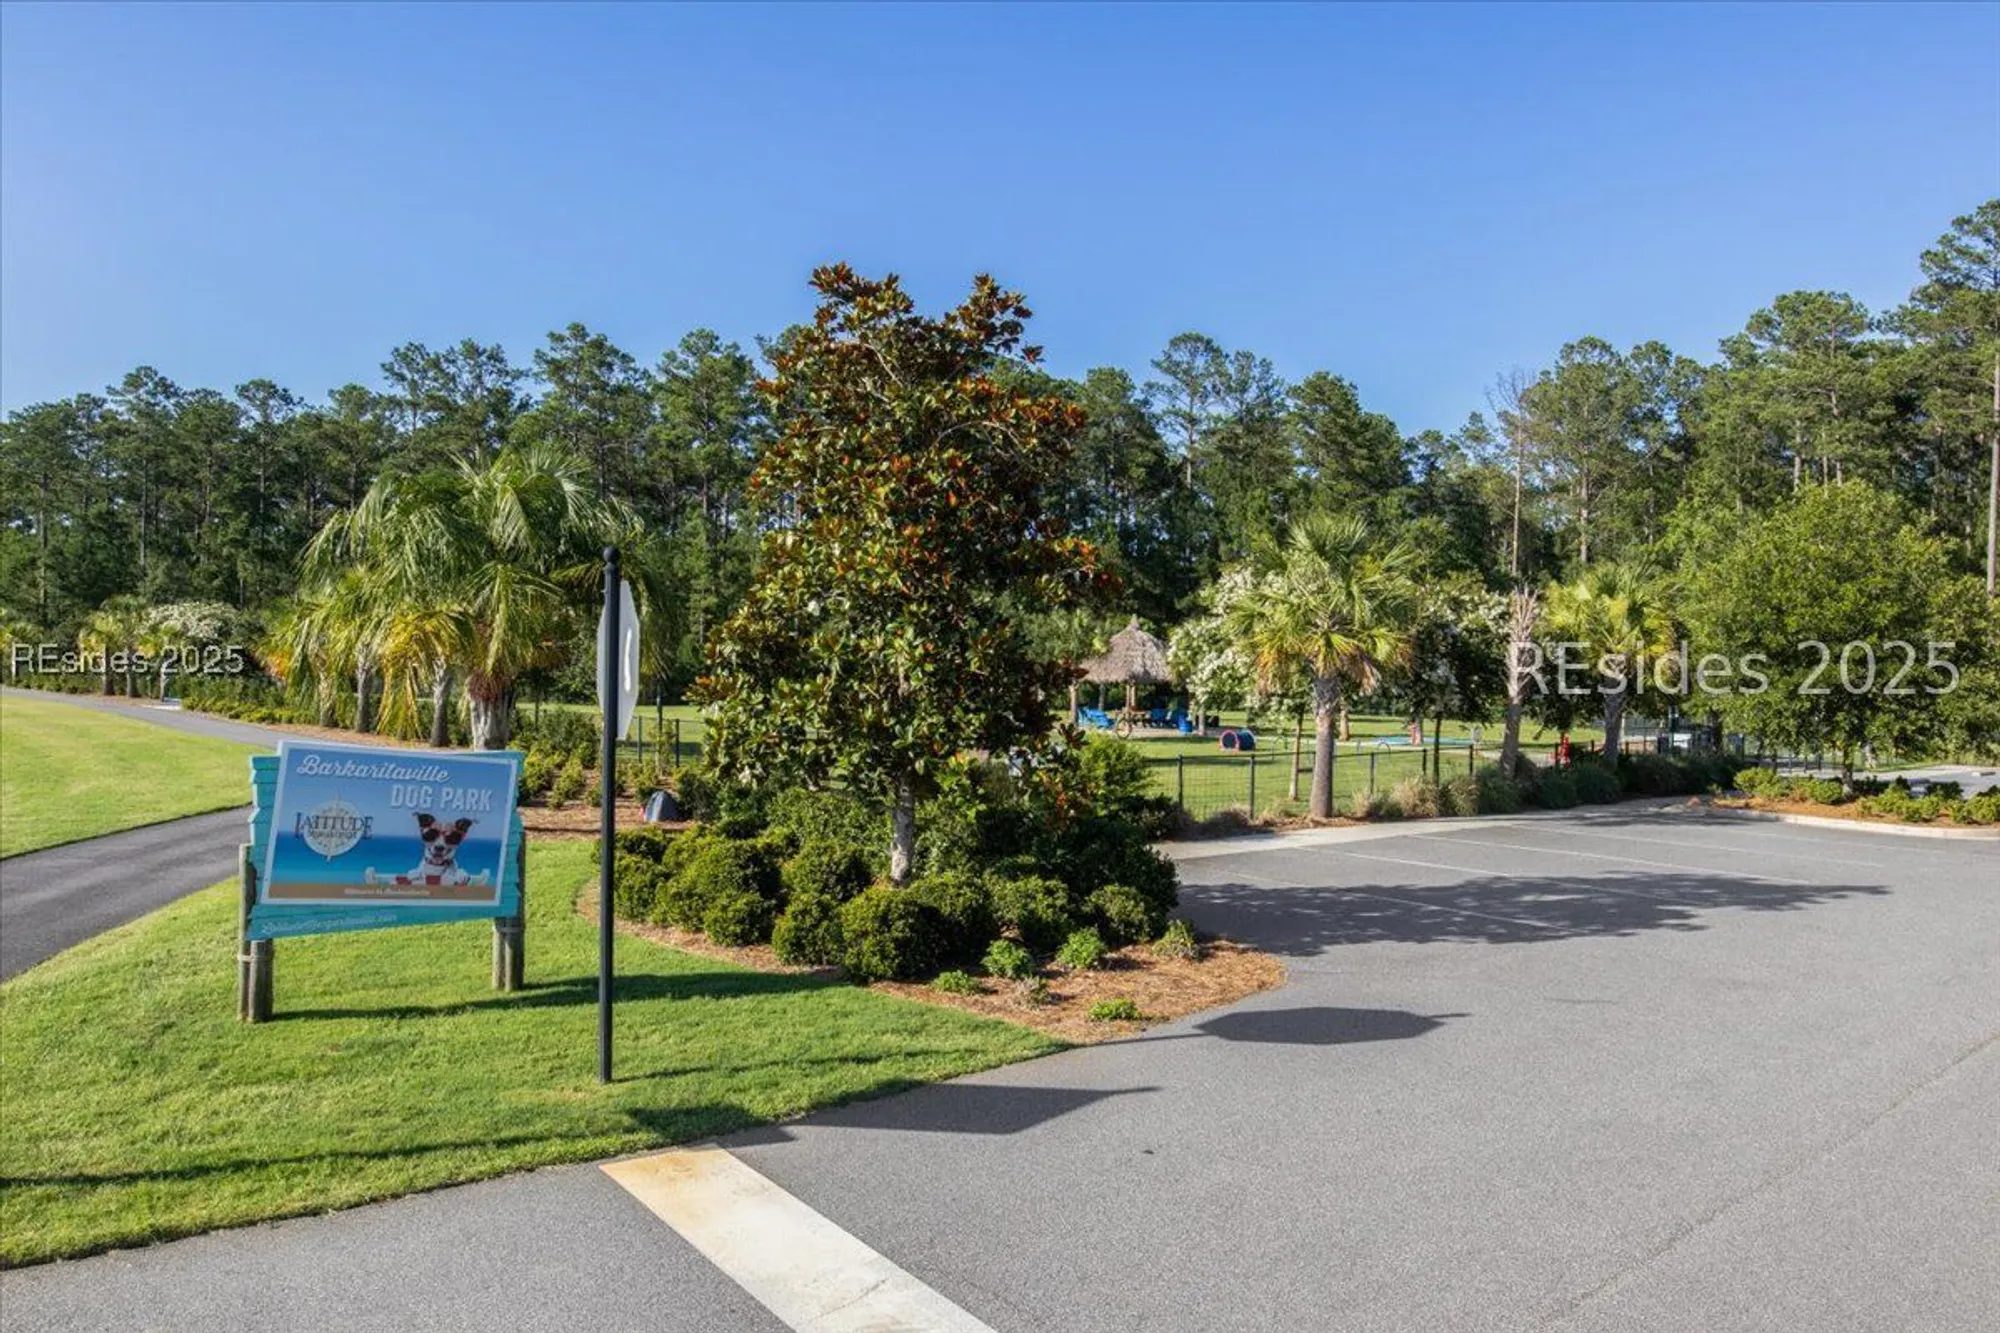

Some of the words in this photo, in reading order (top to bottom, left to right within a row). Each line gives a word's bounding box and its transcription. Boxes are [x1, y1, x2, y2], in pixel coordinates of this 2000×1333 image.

[297, 754, 450, 783] Barkaritaville
[391, 784, 433, 809] DOG
[440, 787, 493, 811] PARK
[294, 811, 374, 840] LATITUDE
